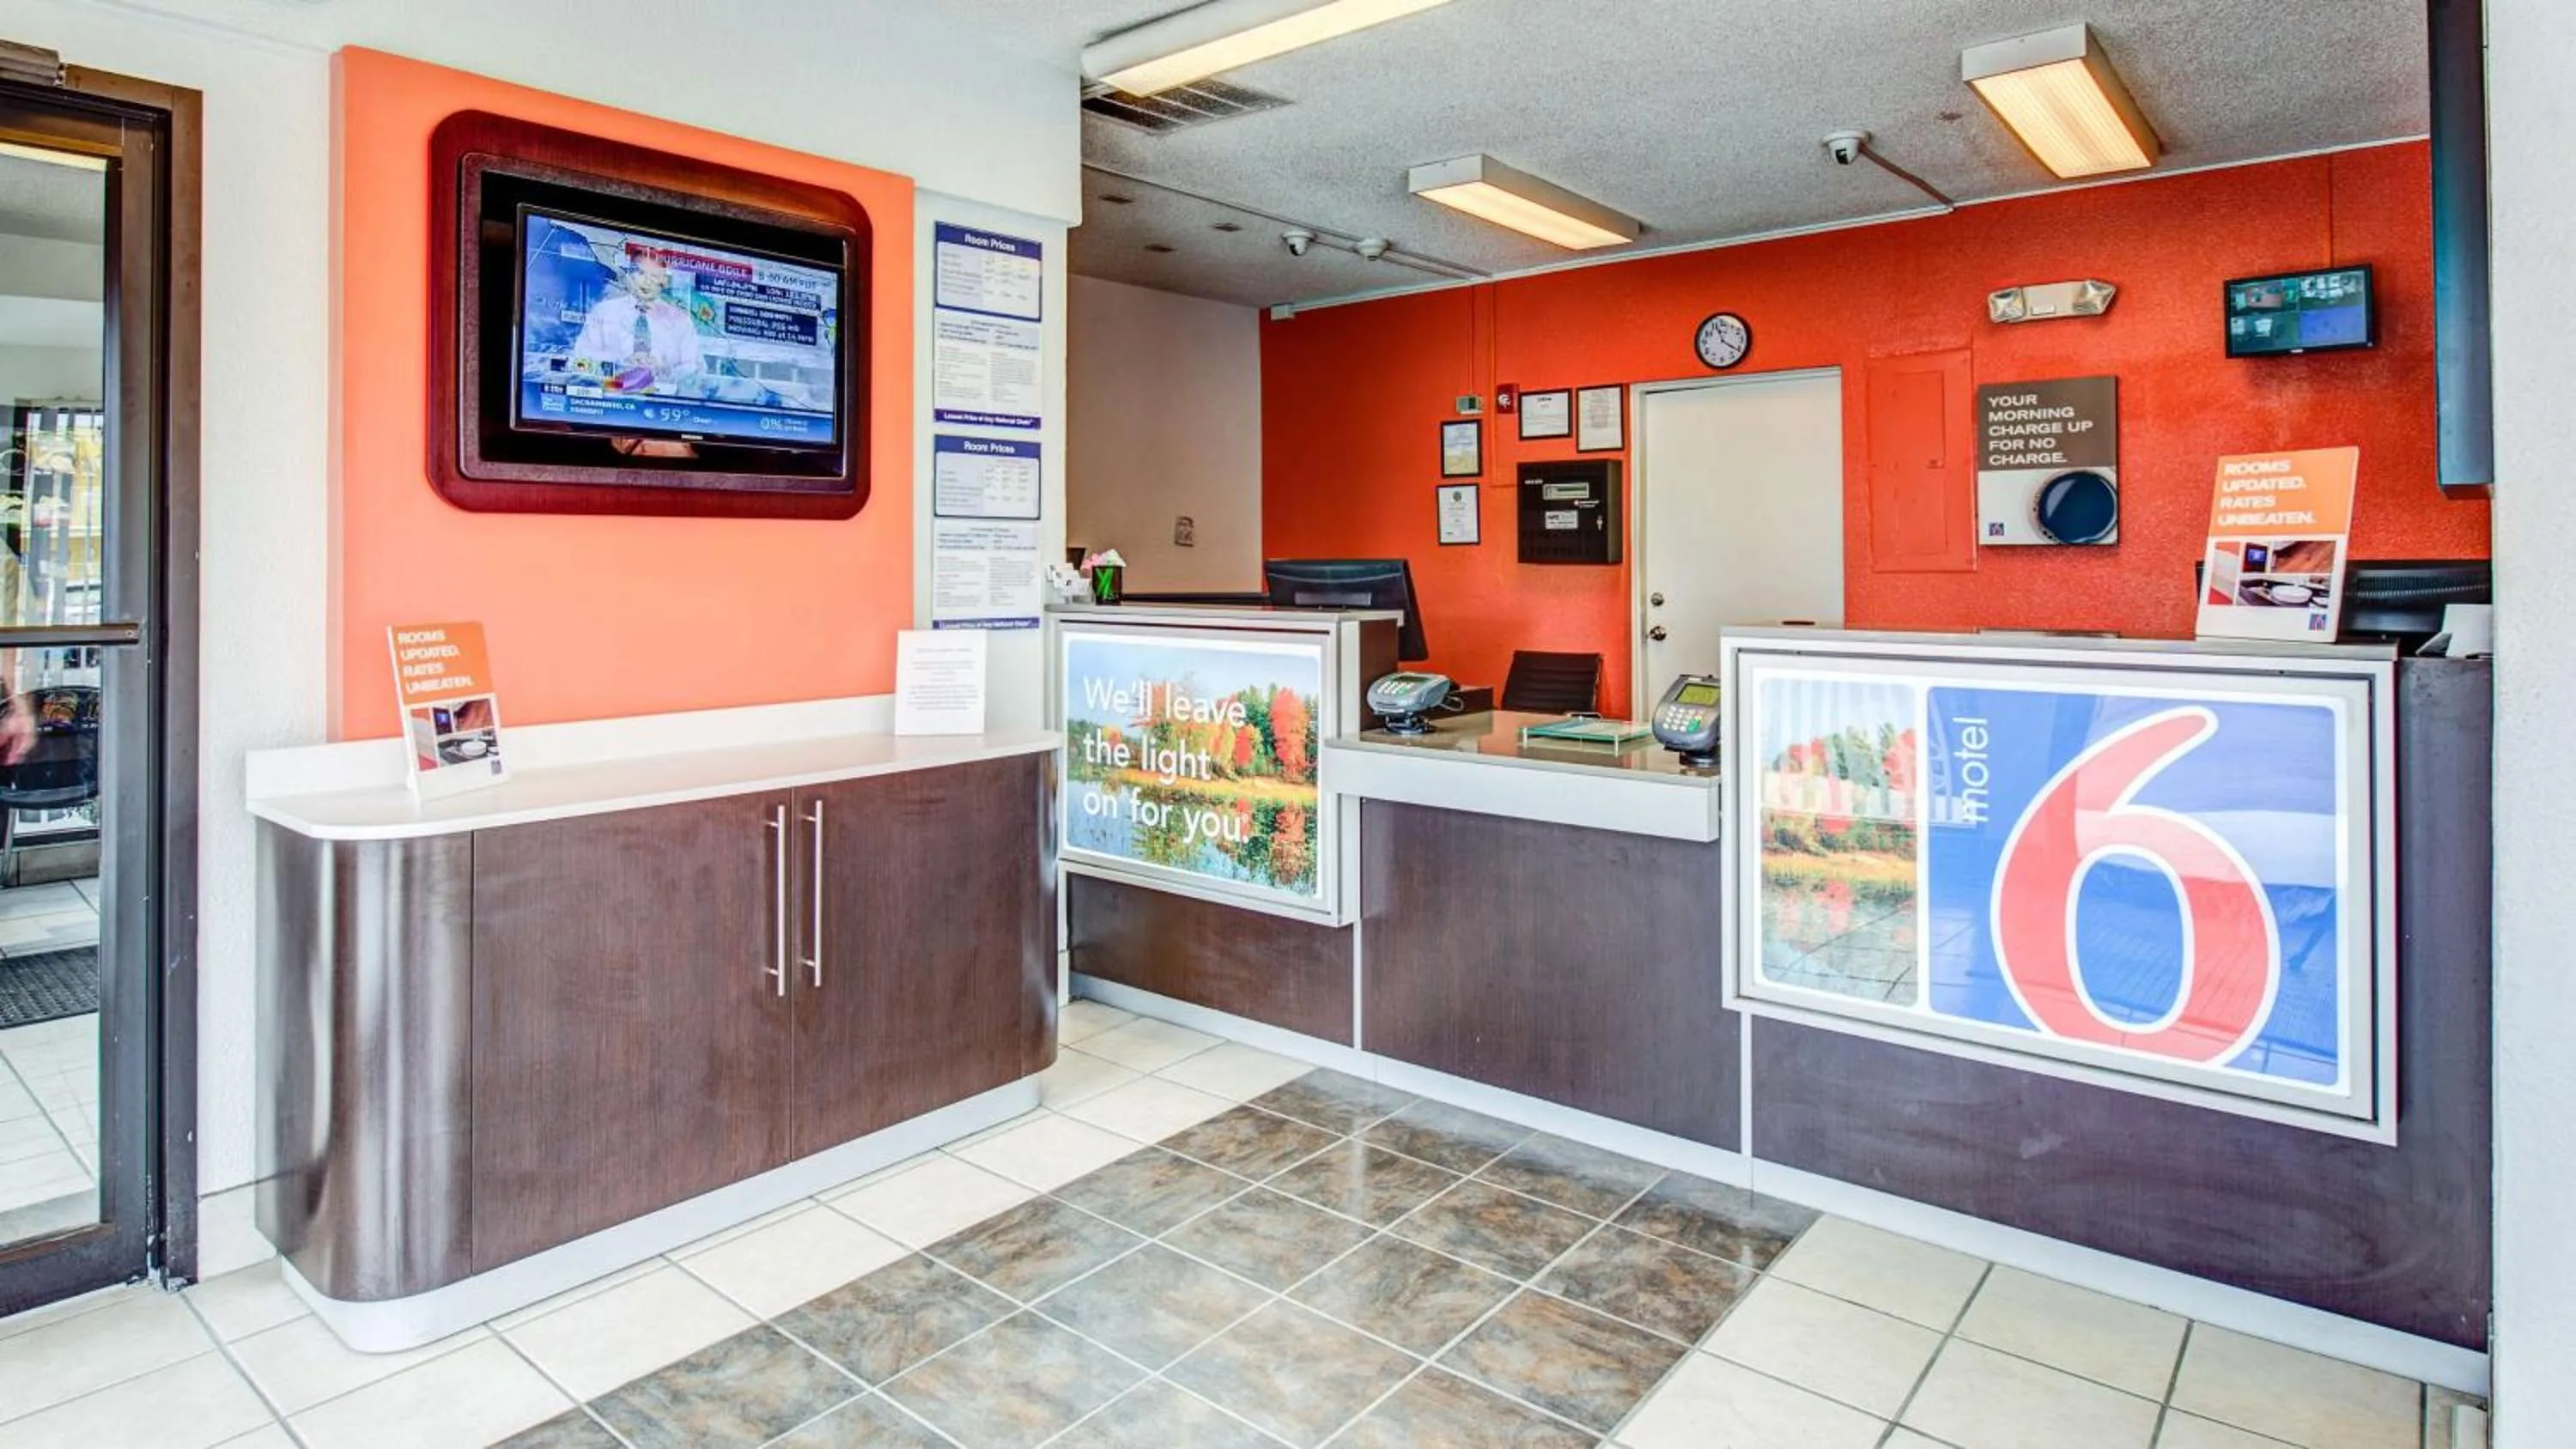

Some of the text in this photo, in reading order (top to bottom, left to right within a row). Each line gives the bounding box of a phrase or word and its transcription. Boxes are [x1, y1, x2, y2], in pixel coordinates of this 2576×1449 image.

[990, 238, 1016, 252] Prices
[1988, 394, 2038, 408] YOUR
[1988, 406, 2075, 421] MORNING
[1988, 421, 2093, 436] CHARGE UP
[1989, 437, 2057, 451] FOR NO
[1989, 452, 2068, 465] CHARGE.
[2224, 459, 2292, 475] ROOMS
[2221, 476, 2307, 493] UPDATED.
[2220, 494, 2276, 509] RATES
[2218, 511, 2317, 526] UNBEATEN.
[398, 630, 445, 643] ROOMS
[403, 662, 445, 676] RATES
[1083, 676, 1247, 728] We'll leave
[1083, 728, 1212, 786] the light
[1953, 716, 1990, 823] motel
[1083, 788, 1250, 845] on for you.
[1990, 705, 2281, 1067] 6
